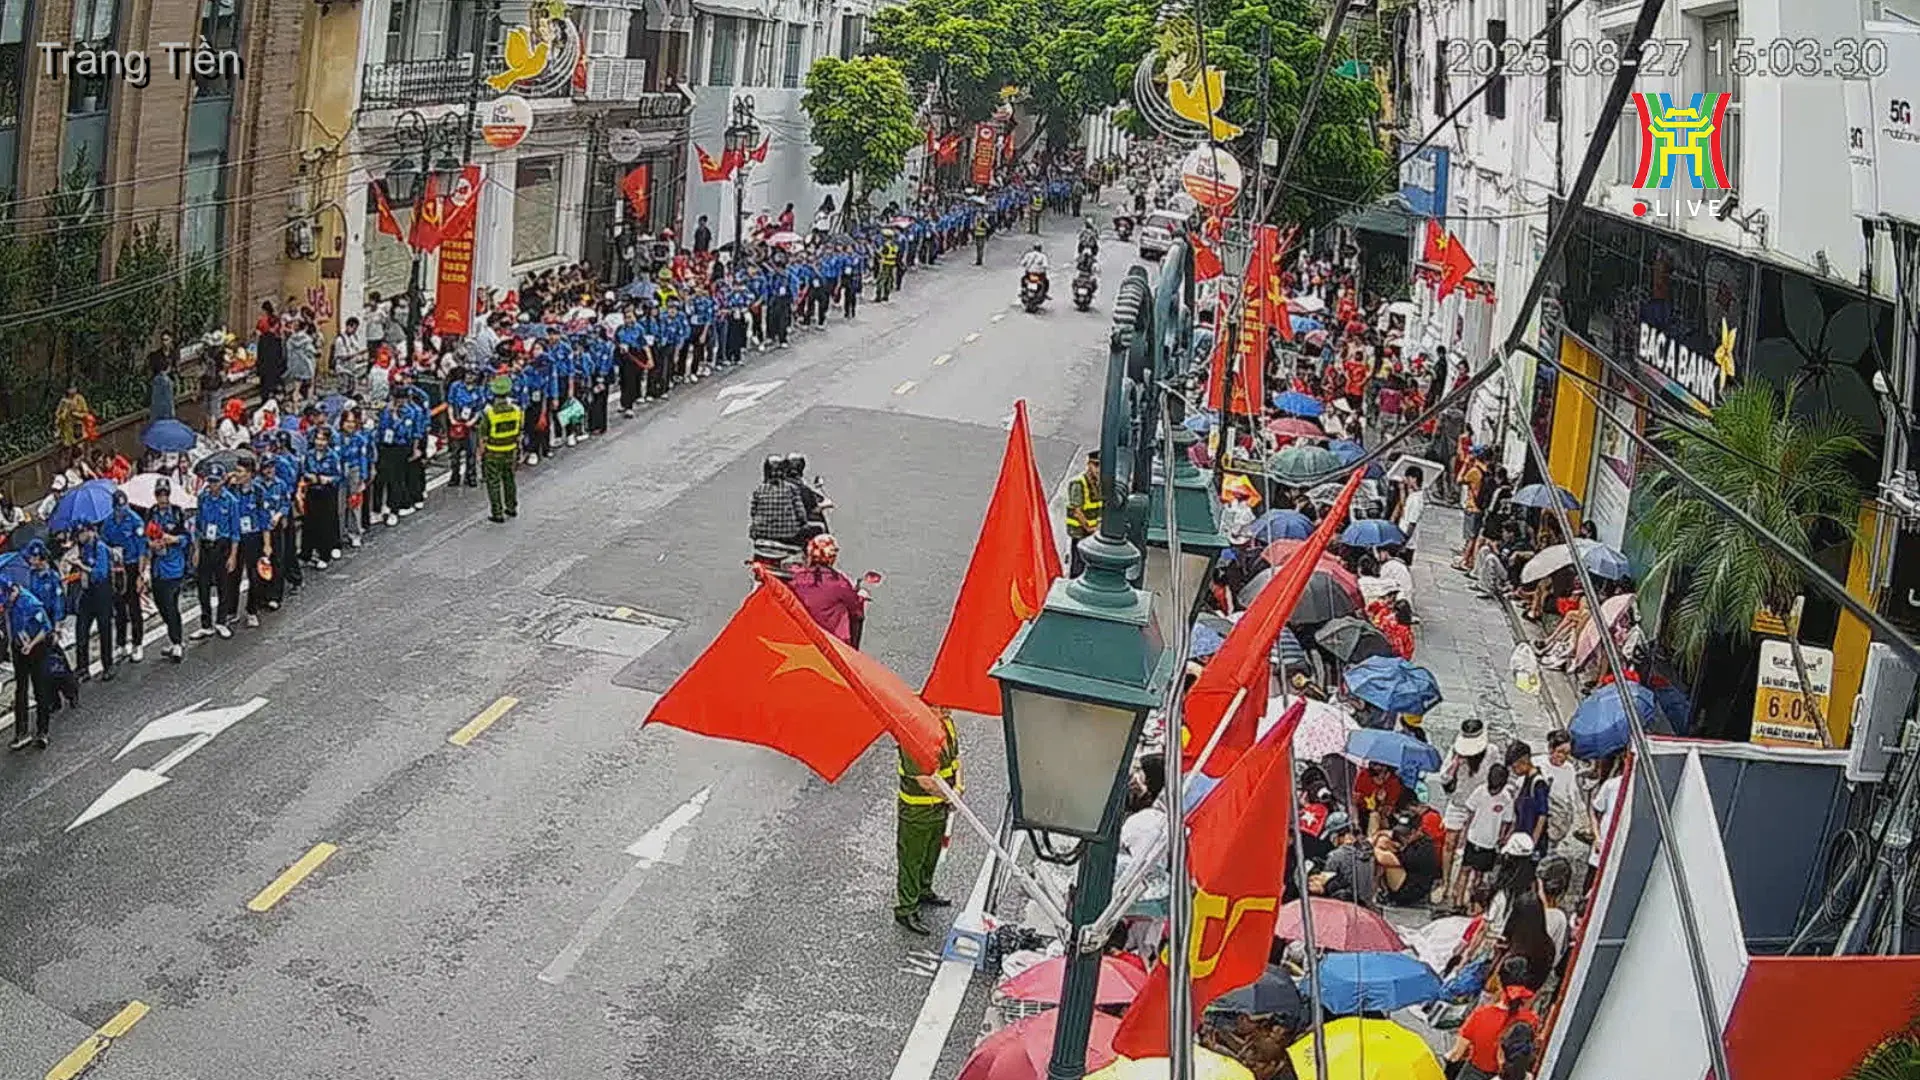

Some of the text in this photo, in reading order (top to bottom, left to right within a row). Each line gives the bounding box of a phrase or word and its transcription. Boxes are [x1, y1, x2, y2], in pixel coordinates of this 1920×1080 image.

[1890, 99, 1910, 124] 5G
[1639, 321, 1720, 407] BAC A BANK
